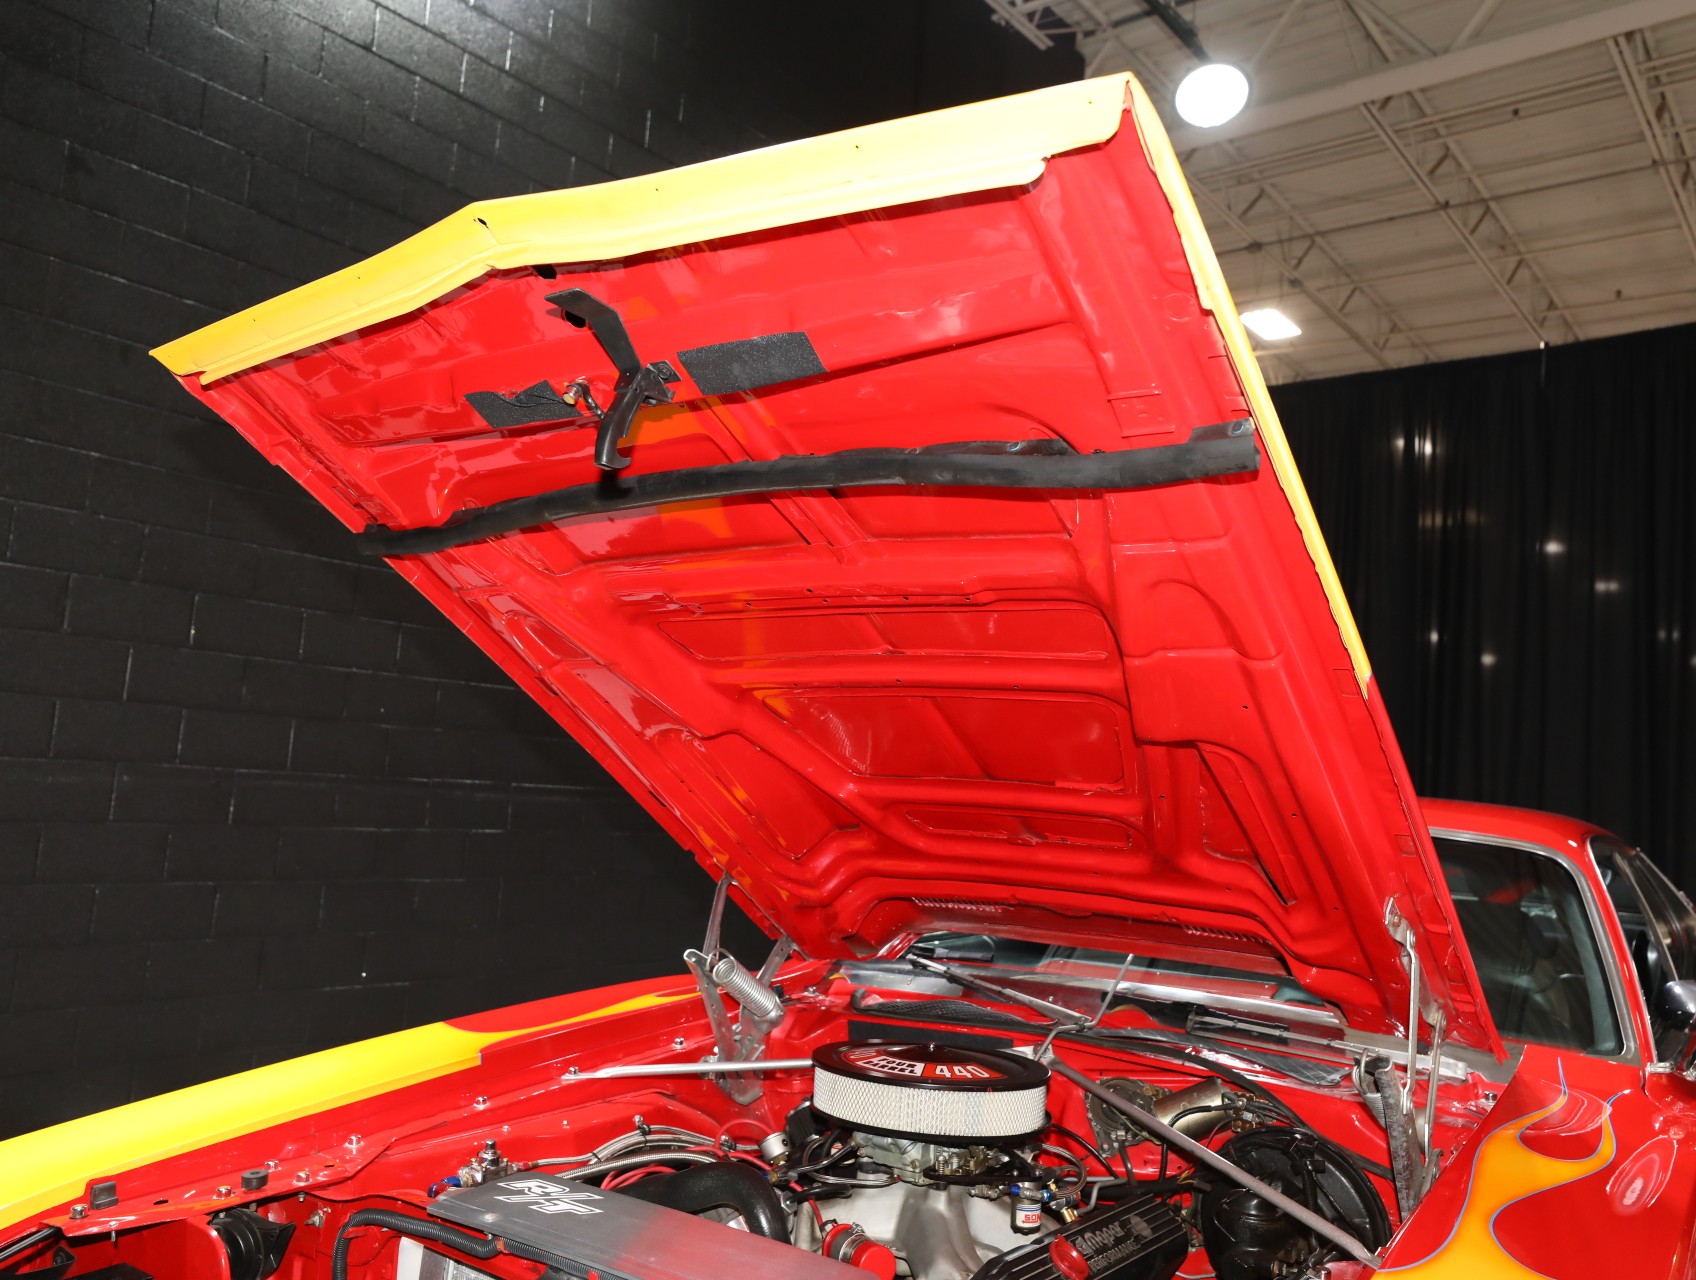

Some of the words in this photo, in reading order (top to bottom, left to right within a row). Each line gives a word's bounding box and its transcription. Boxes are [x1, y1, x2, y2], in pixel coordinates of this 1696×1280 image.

[863, 1060, 918, 1075] BARREL
[877, 1057, 917, 1069] FOUR
[935, 1065, 990, 1079] 440
[494, 1179, 604, 1215] R/T
[1084, 1221, 1126, 1251] Mopar
[1087, 1239, 1140, 1273] PERFORMANCE
